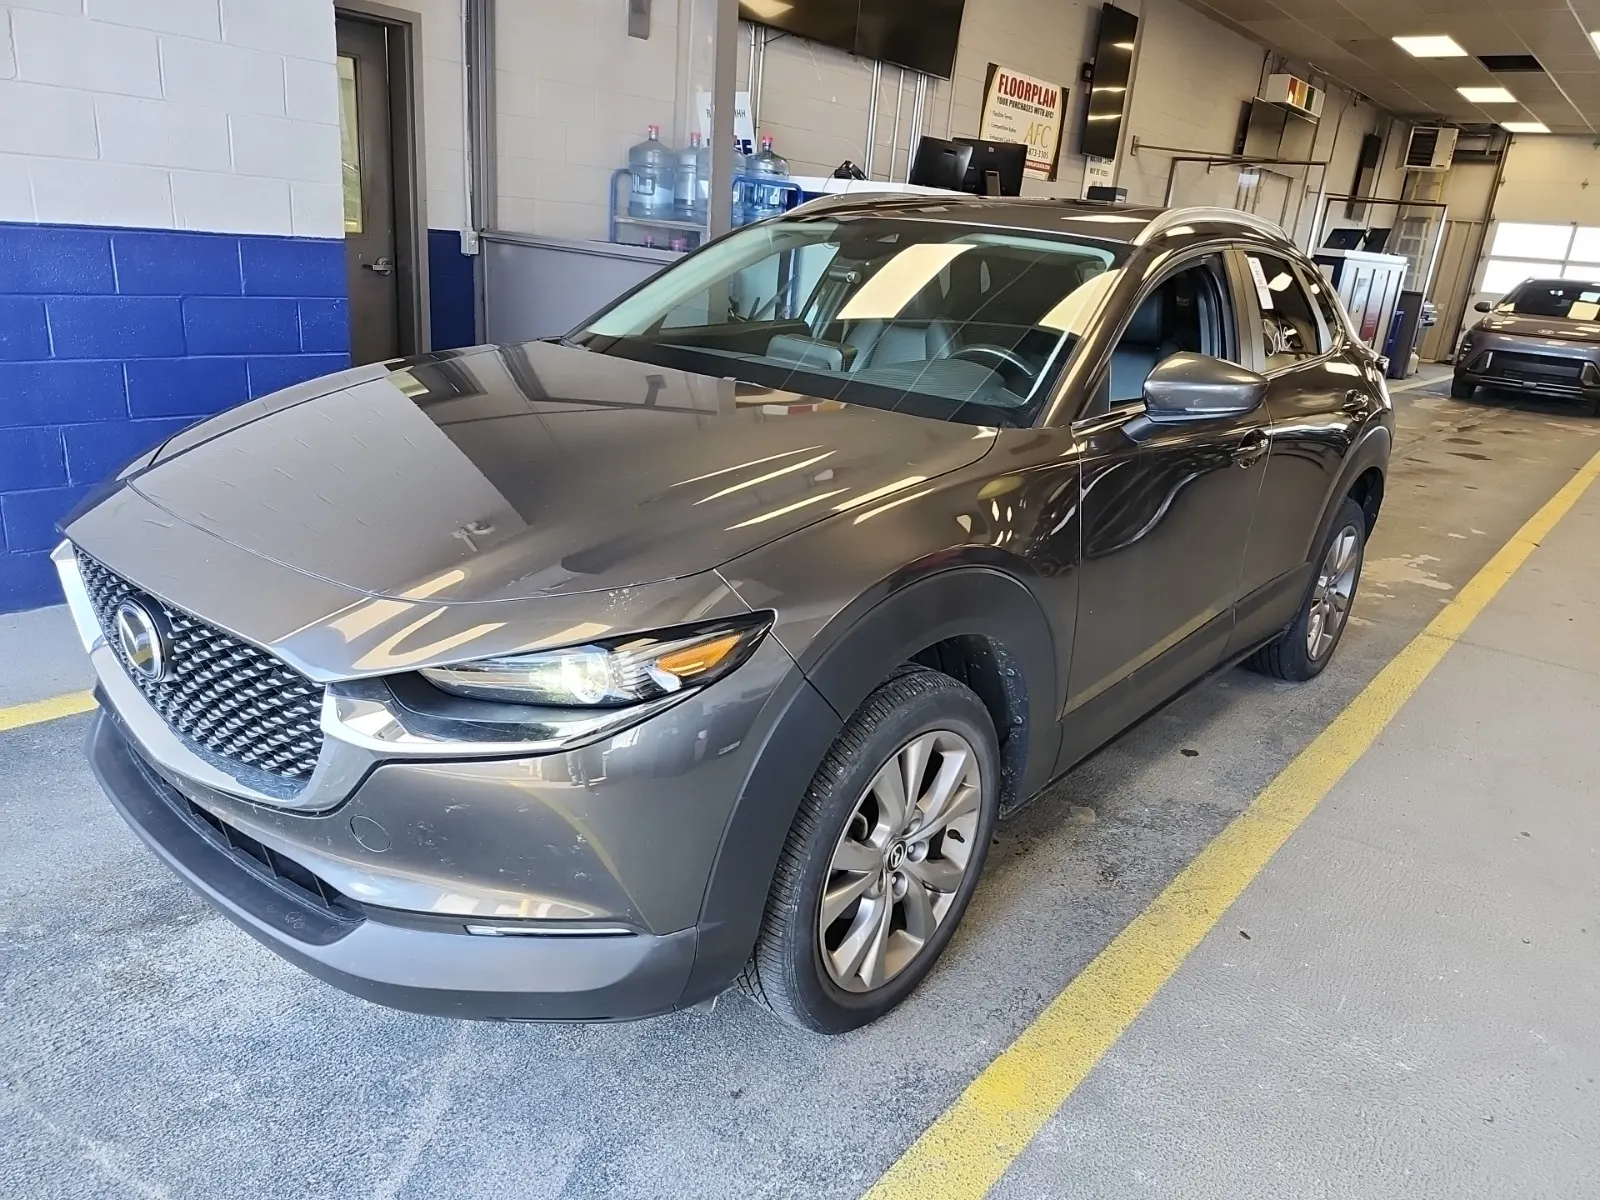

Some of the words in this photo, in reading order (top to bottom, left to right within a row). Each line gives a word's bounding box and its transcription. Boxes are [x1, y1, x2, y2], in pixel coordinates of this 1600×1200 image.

[997, 73, 1058, 109] FLOORPLAN
[997, 96, 1008, 106] YOUR
[1009, 99, 1034, 113] PURCHASES
[1034, 106, 1045, 117] WITH
[1023, 121, 1052, 149] AFC
